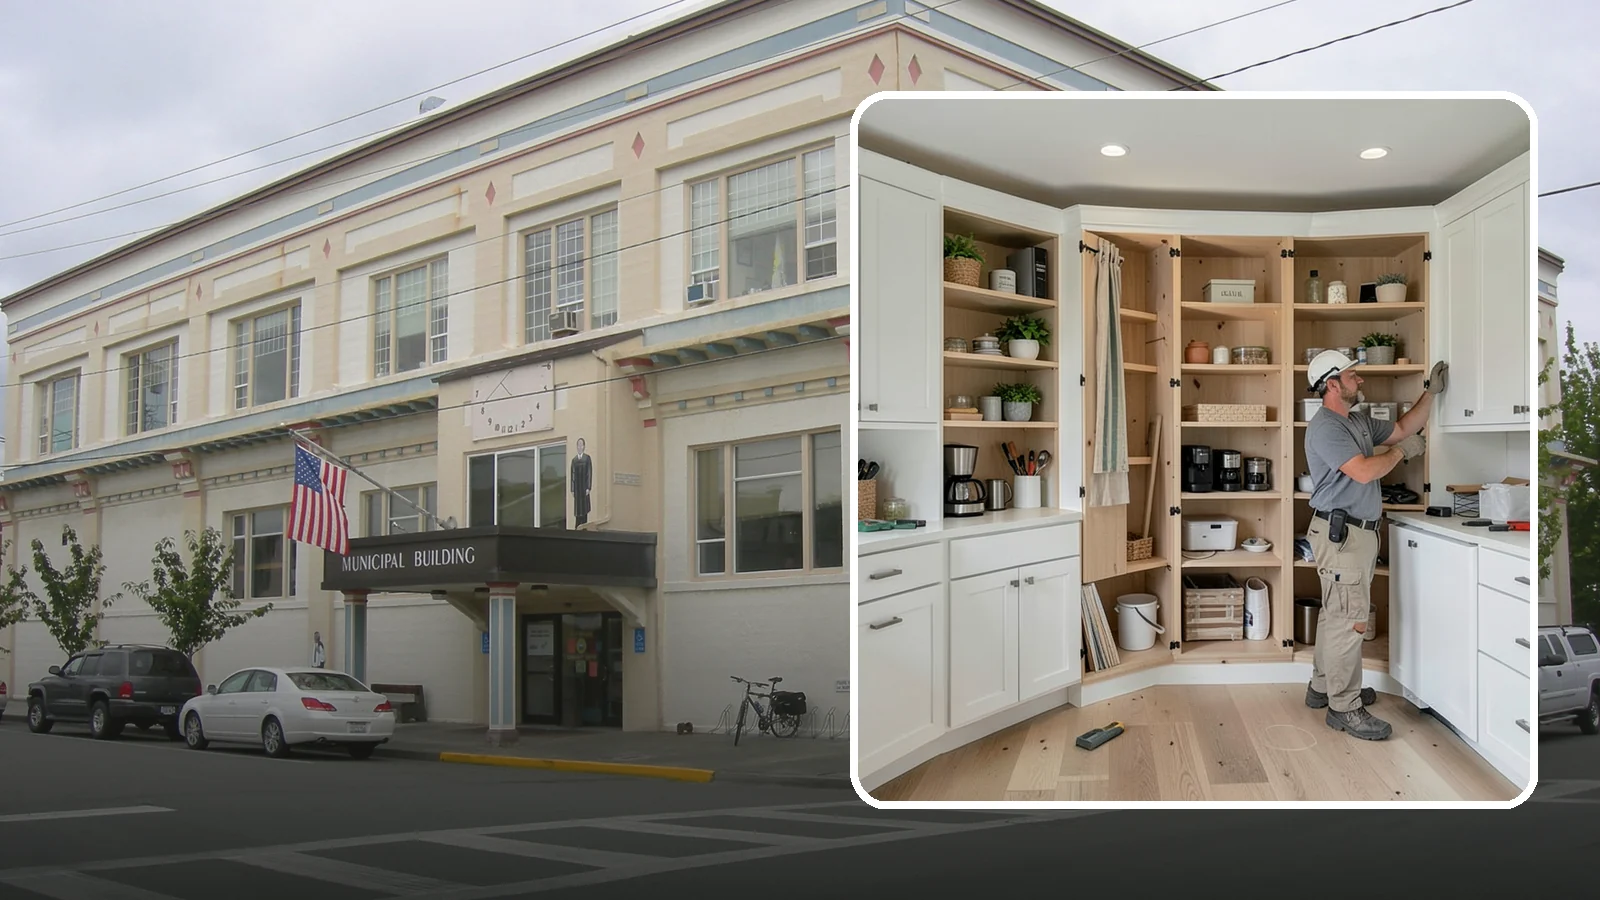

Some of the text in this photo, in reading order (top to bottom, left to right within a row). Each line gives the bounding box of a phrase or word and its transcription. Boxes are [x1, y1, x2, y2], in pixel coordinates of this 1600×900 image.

[546, 361, 552, 370] 6
[481, 407, 485, 415] 8
[487, 417, 492, 426] 9
[521, 420, 525, 428] 2
[494, 423, 500, 431] 10
[507, 425, 513, 433] 12
[342, 546, 475, 572] MUNICIPAL BUILDING
